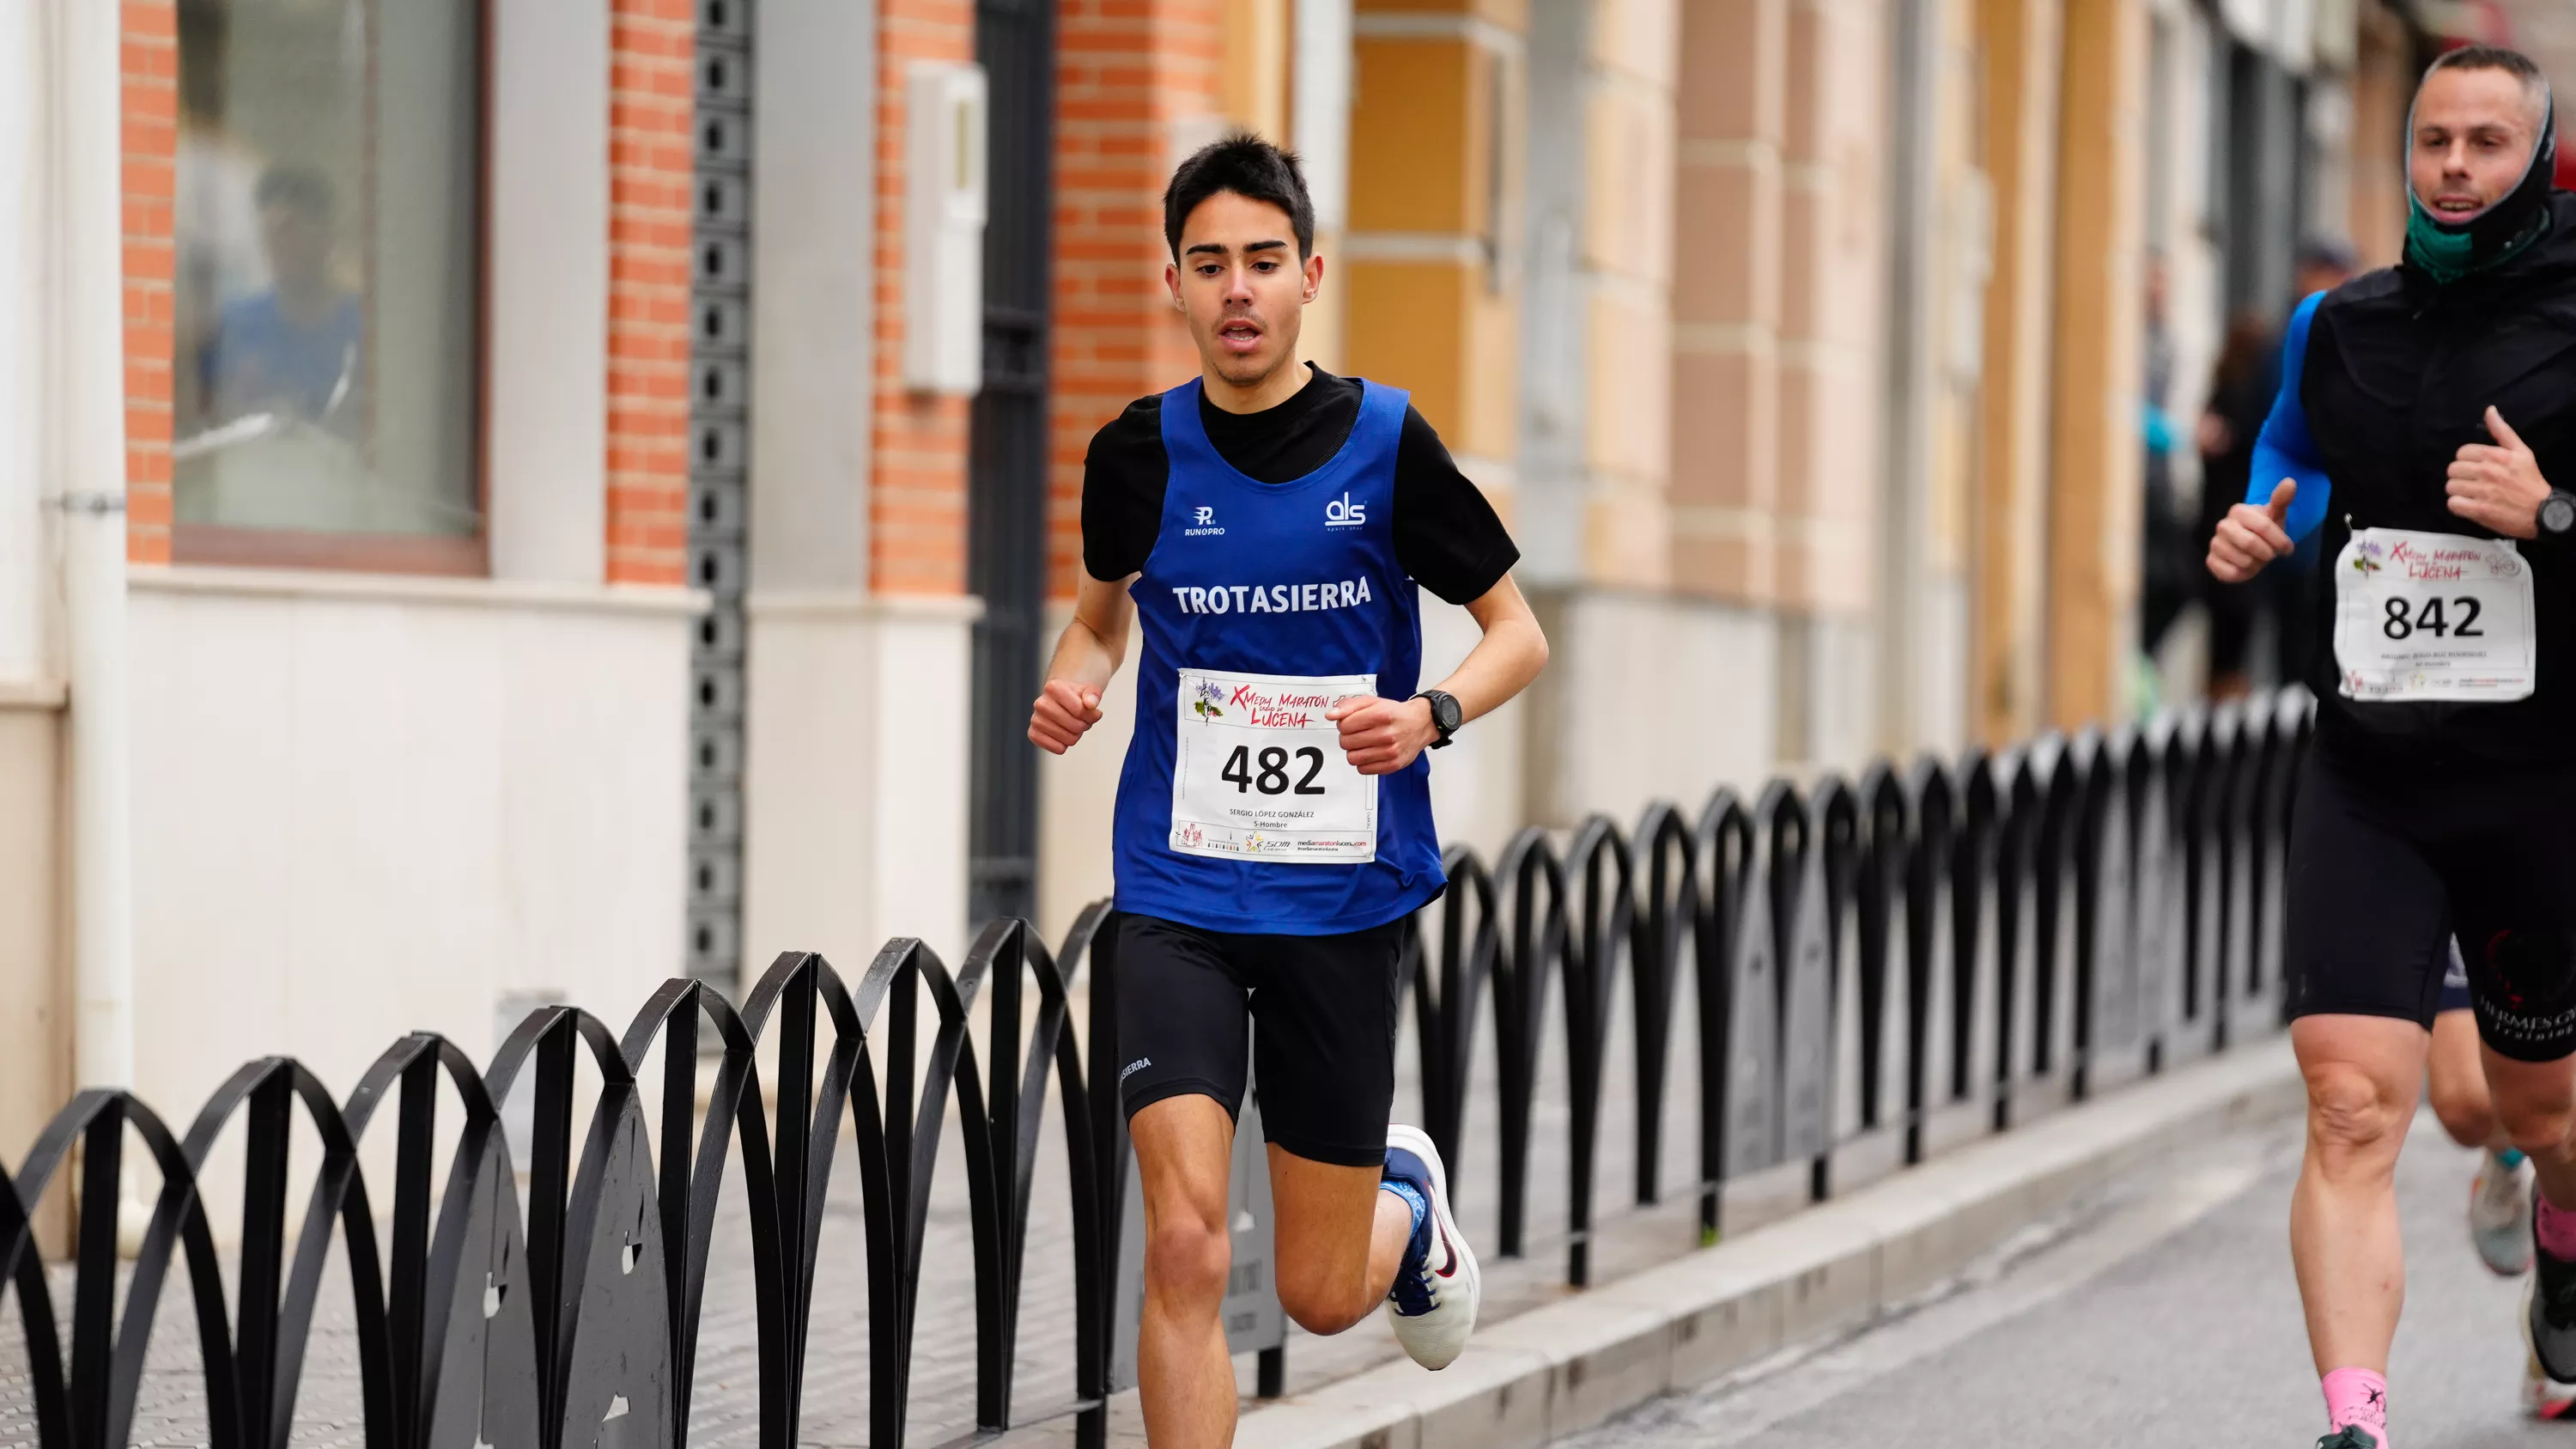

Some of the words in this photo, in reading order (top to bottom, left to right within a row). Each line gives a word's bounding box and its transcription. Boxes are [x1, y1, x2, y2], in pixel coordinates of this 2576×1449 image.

[1325, 491, 1366, 527] als
[1185, 527, 1225, 536] RUNOPRO
[2409, 563, 2470, 581] LUCENA
[1172, 575, 1371, 615] TROTASIERRA
[2384, 595, 2484, 640] 842
[1230, 685, 1250, 711] X
[1244, 691, 1273, 706] MEDIA
[1279, 693, 1329, 708] MARATÓN
[1250, 708, 1315, 728] LUCENA
[1221, 745, 1325, 795] 482
[1230, 808, 1253, 817] SERGIO
[1255, 808, 1277, 818] LÓPEZ
